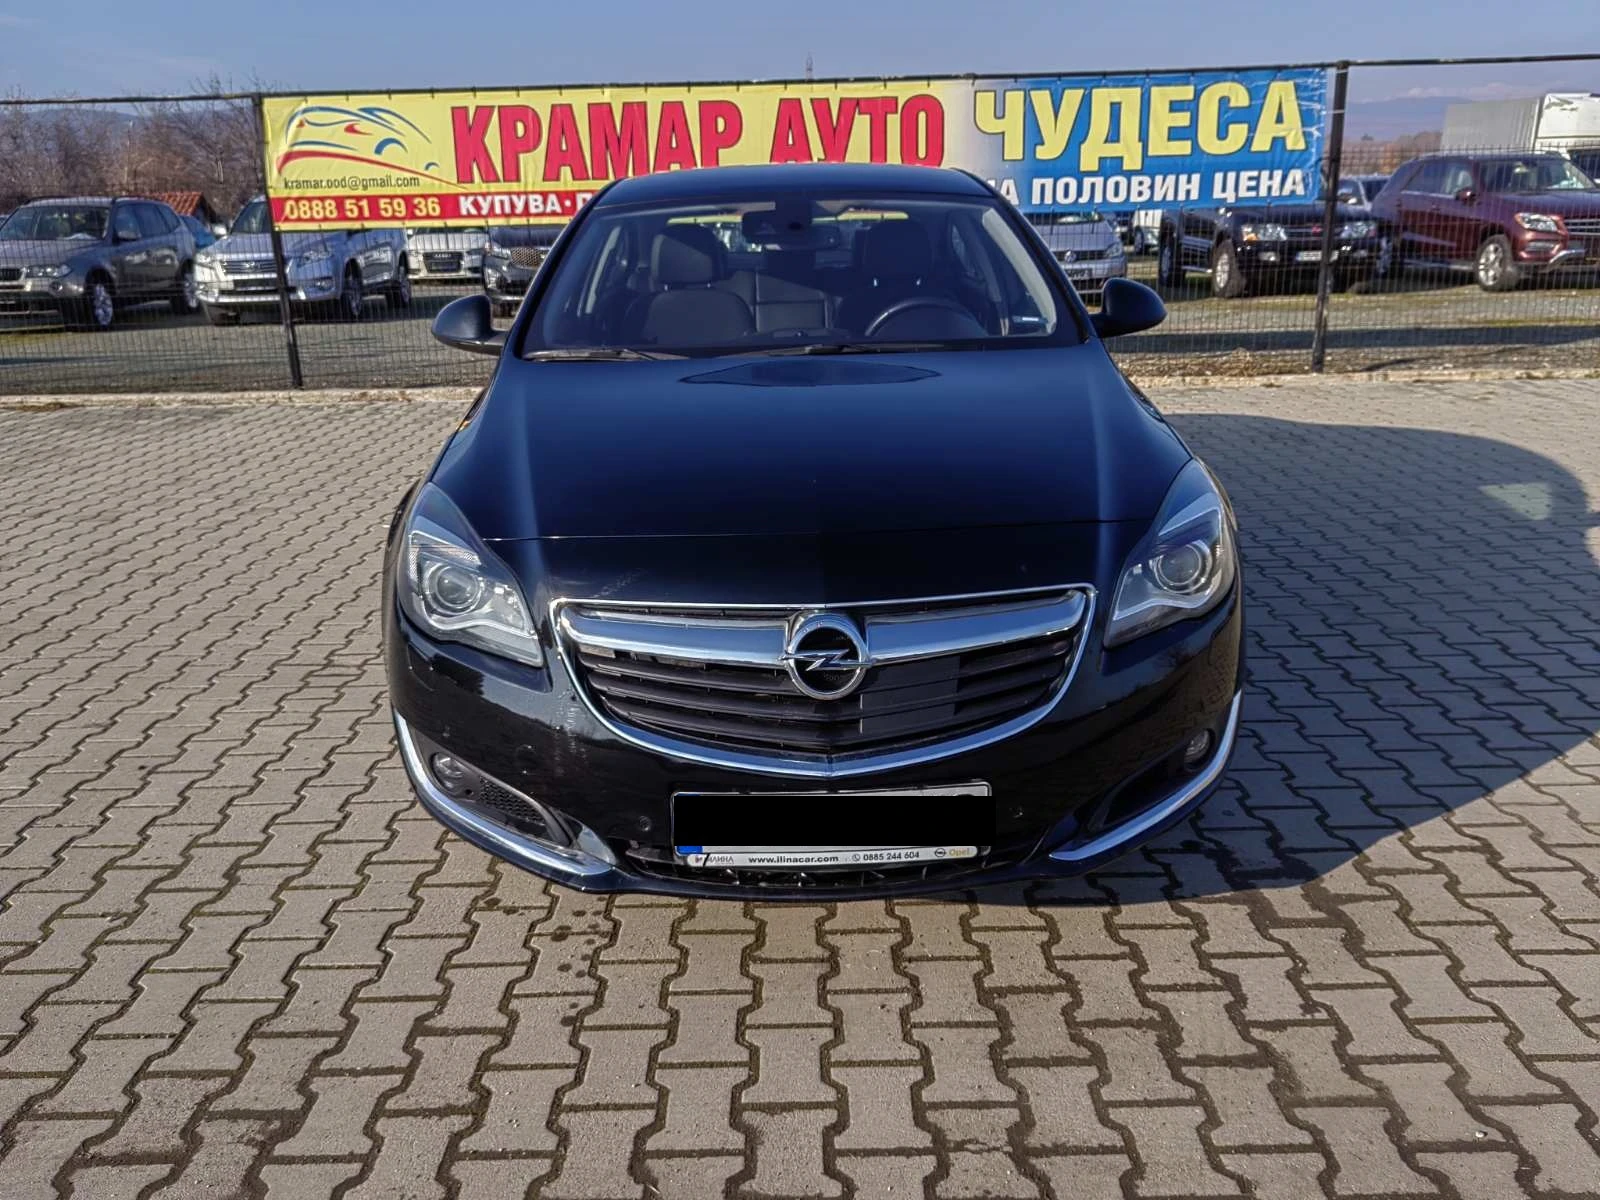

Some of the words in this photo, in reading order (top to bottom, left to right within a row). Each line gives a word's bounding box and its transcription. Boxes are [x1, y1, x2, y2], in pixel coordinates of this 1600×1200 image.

[450, 99, 743, 184] КРАМАР
[769, 94, 945, 168] АУТО
[973, 80, 1306, 172] ЧУДЕСА
[283, 175, 420, 191] kramar.ood@gmail.com
[1031, 172, 1200, 206] ПОЛОВИН
[1212, 168, 1306, 204] ЦЕНА
[285, 199, 338, 220] 0888
[344, 198, 370, 218] 51
[379, 197, 407, 217] 59
[413, 196, 441, 216] 36
[748, 855, 839, 864] www.ilinacar.com
[863, 853, 884, 861] 0885
[886, 852, 902, 860] 244
[904, 851, 920, 859] 604
